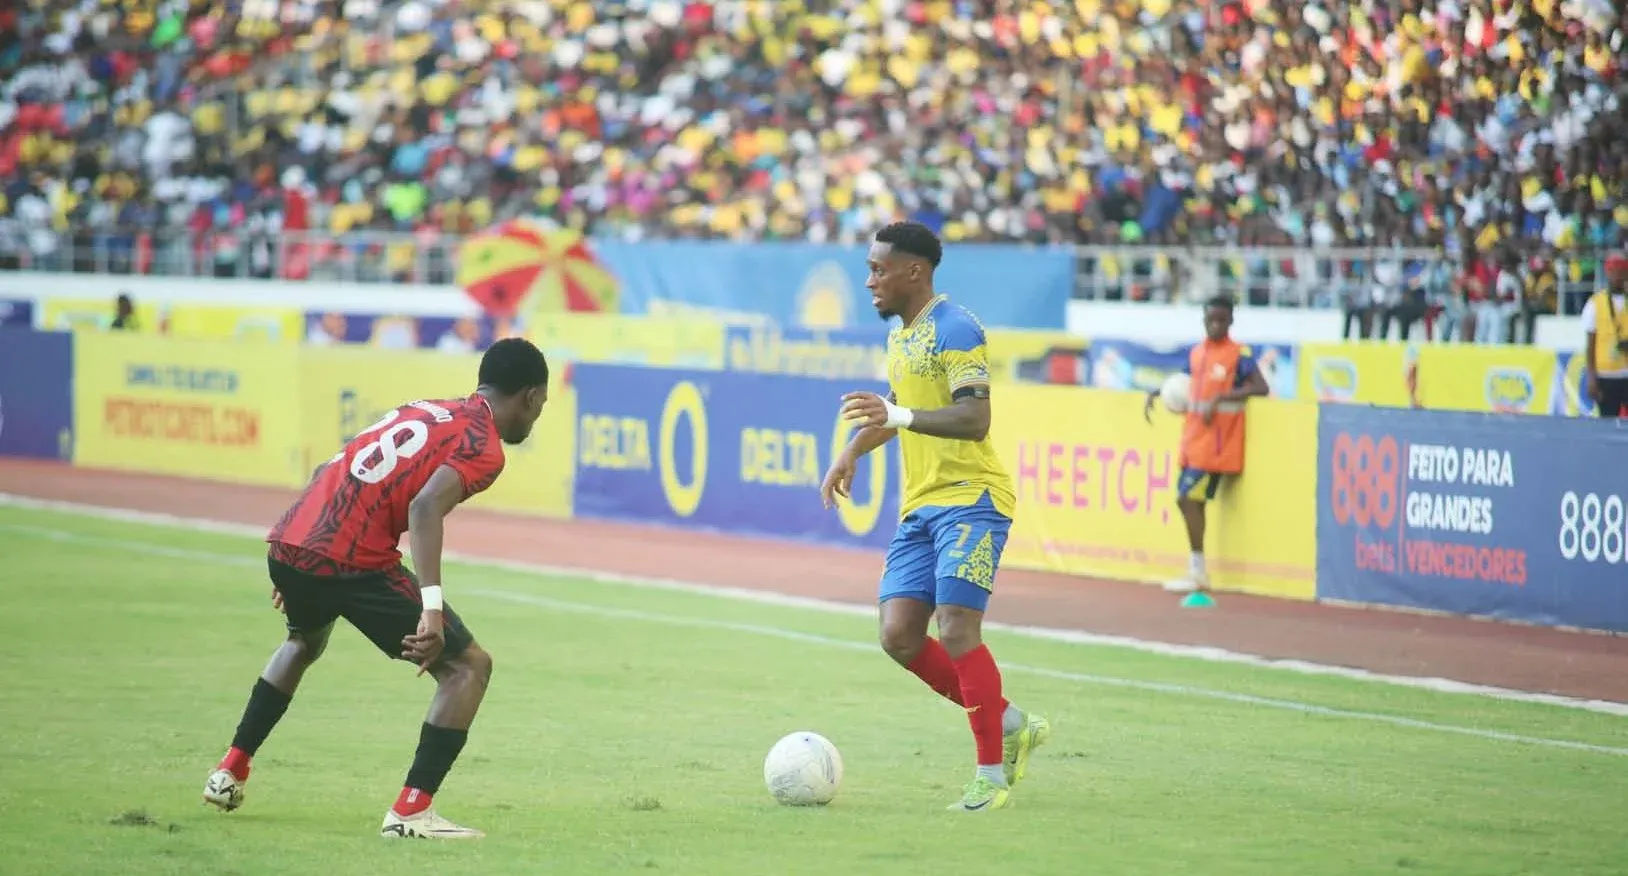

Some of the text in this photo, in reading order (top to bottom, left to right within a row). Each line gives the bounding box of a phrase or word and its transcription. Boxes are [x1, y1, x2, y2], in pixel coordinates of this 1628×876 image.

[580, 414, 651, 470] DELTA
[740, 427, 819, 487] DELTA
[1408, 443, 1514, 487] FEITO PARA
[1332, 431, 1398, 530] 888
[956, 523, 972, 550] 7
[1406, 491, 1493, 535] GRANDES
[1559, 490, 1628, 566] 888
[1355, 533, 1396, 574] bets
[1405, 539, 1528, 586] VENCEDORES
